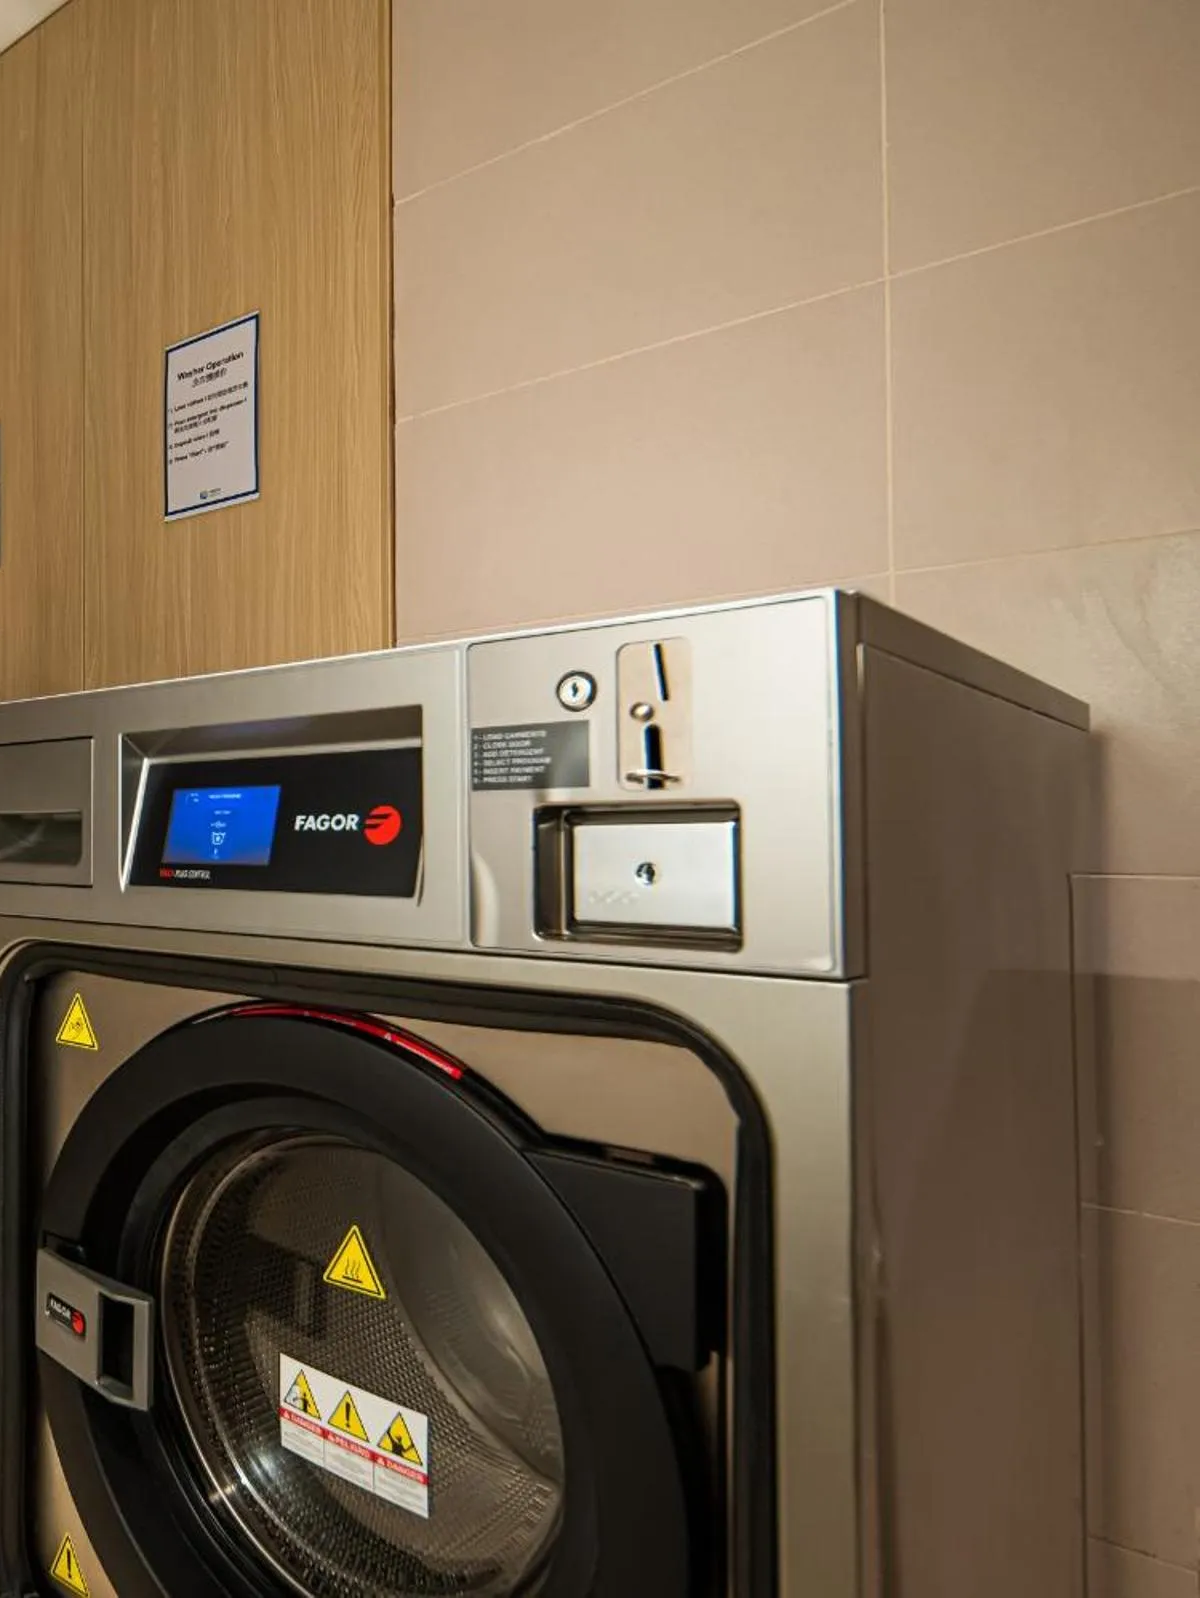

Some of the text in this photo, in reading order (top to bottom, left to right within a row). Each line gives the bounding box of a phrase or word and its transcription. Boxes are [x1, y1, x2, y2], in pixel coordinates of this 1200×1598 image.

[177, 352, 244, 381] Washer Operation
[510, 765, 545, 773] PAYMENT
[508, 775, 533, 783] START
[294, 813, 359, 832] FAGOR
